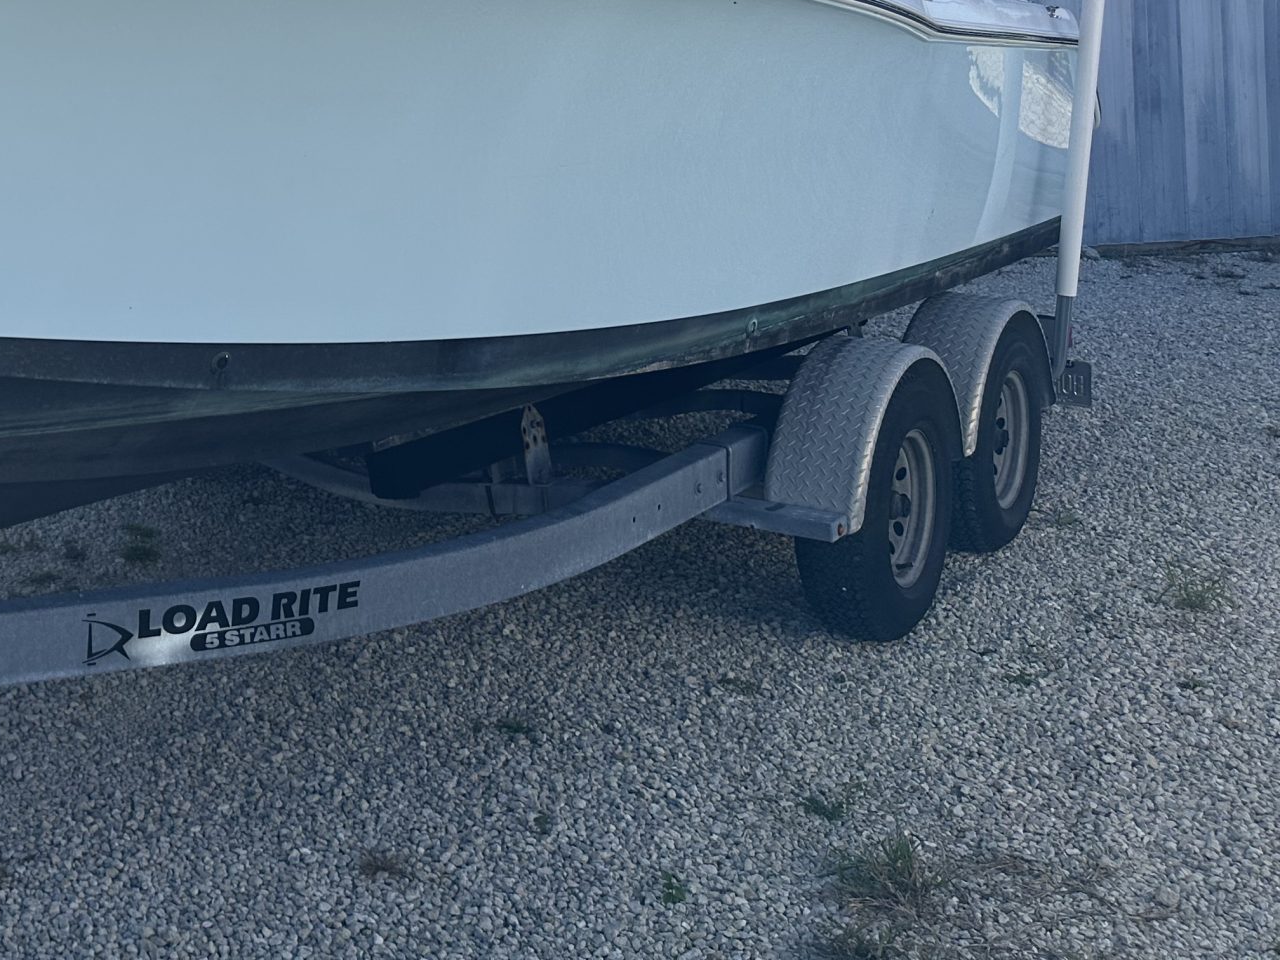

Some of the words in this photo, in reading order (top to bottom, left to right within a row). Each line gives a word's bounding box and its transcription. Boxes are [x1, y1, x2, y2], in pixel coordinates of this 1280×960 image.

[137, 596, 260, 639] LOAD
[271, 580, 361, 621] RITE
[204, 633, 220, 648] 5
[224, 621, 302, 647] STARR
